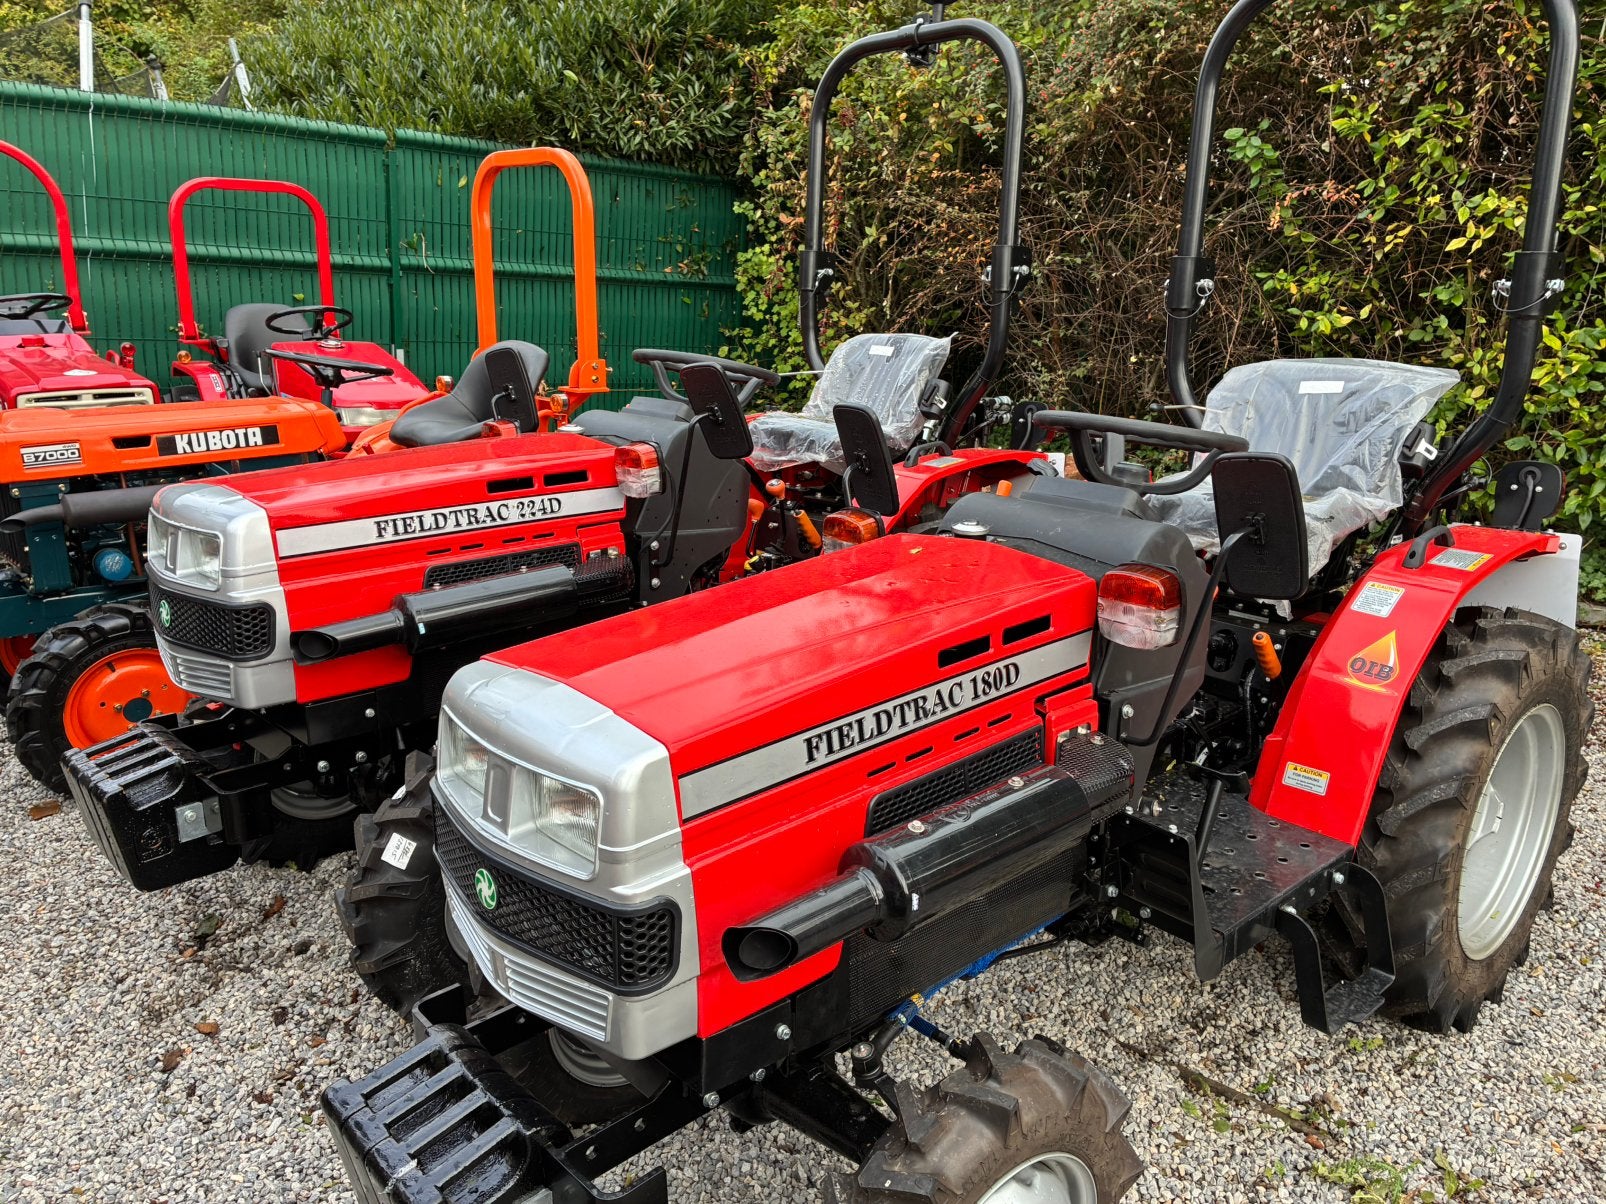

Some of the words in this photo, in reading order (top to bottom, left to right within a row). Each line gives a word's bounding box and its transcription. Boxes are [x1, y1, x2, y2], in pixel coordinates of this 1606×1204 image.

[174, 427, 263, 454] KUBOTA
[23, 449, 80, 463] B7000
[374, 503, 510, 538] FIELDTRAC
[516, 497, 562, 519] 224D
[803, 680, 965, 764] FIELDTRAC
[969, 661, 1020, 701] 180D
[1299, 767, 1323, 778] CAUTION
